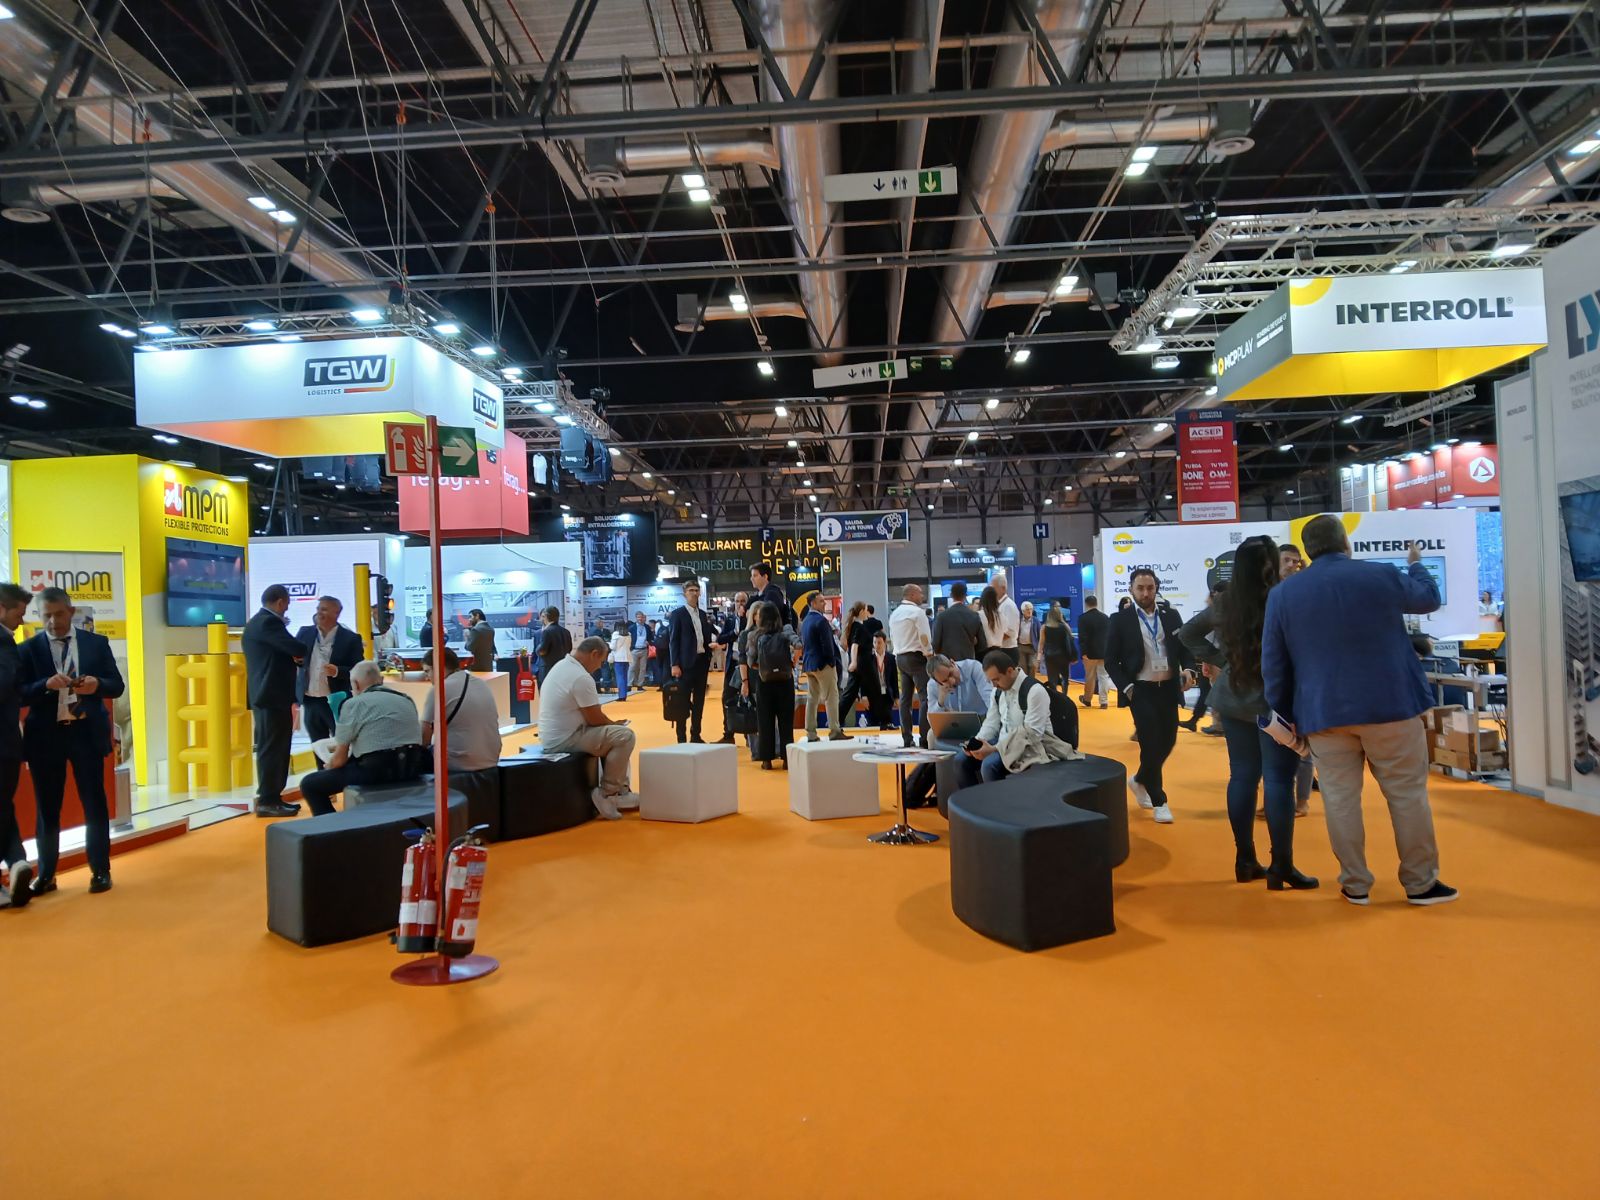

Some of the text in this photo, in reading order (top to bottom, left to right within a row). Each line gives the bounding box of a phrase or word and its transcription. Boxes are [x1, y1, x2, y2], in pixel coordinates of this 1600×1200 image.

[1336, 297, 1513, 325] INTERROLL
[309, 359, 383, 381] TGW
[307, 388, 341, 396] LOGISTICS
[474, 391, 496, 418] TGW
[1191, 428, 1221, 437] ACSEP
[164, 517, 229, 537] FLEXIBLE PROTECTIONS
[1036, 524, 1046, 537] H
[763, 529, 770, 541] F
[676, 539, 752, 552] RESTAURANTE
[726, 559, 745, 571] DEL
